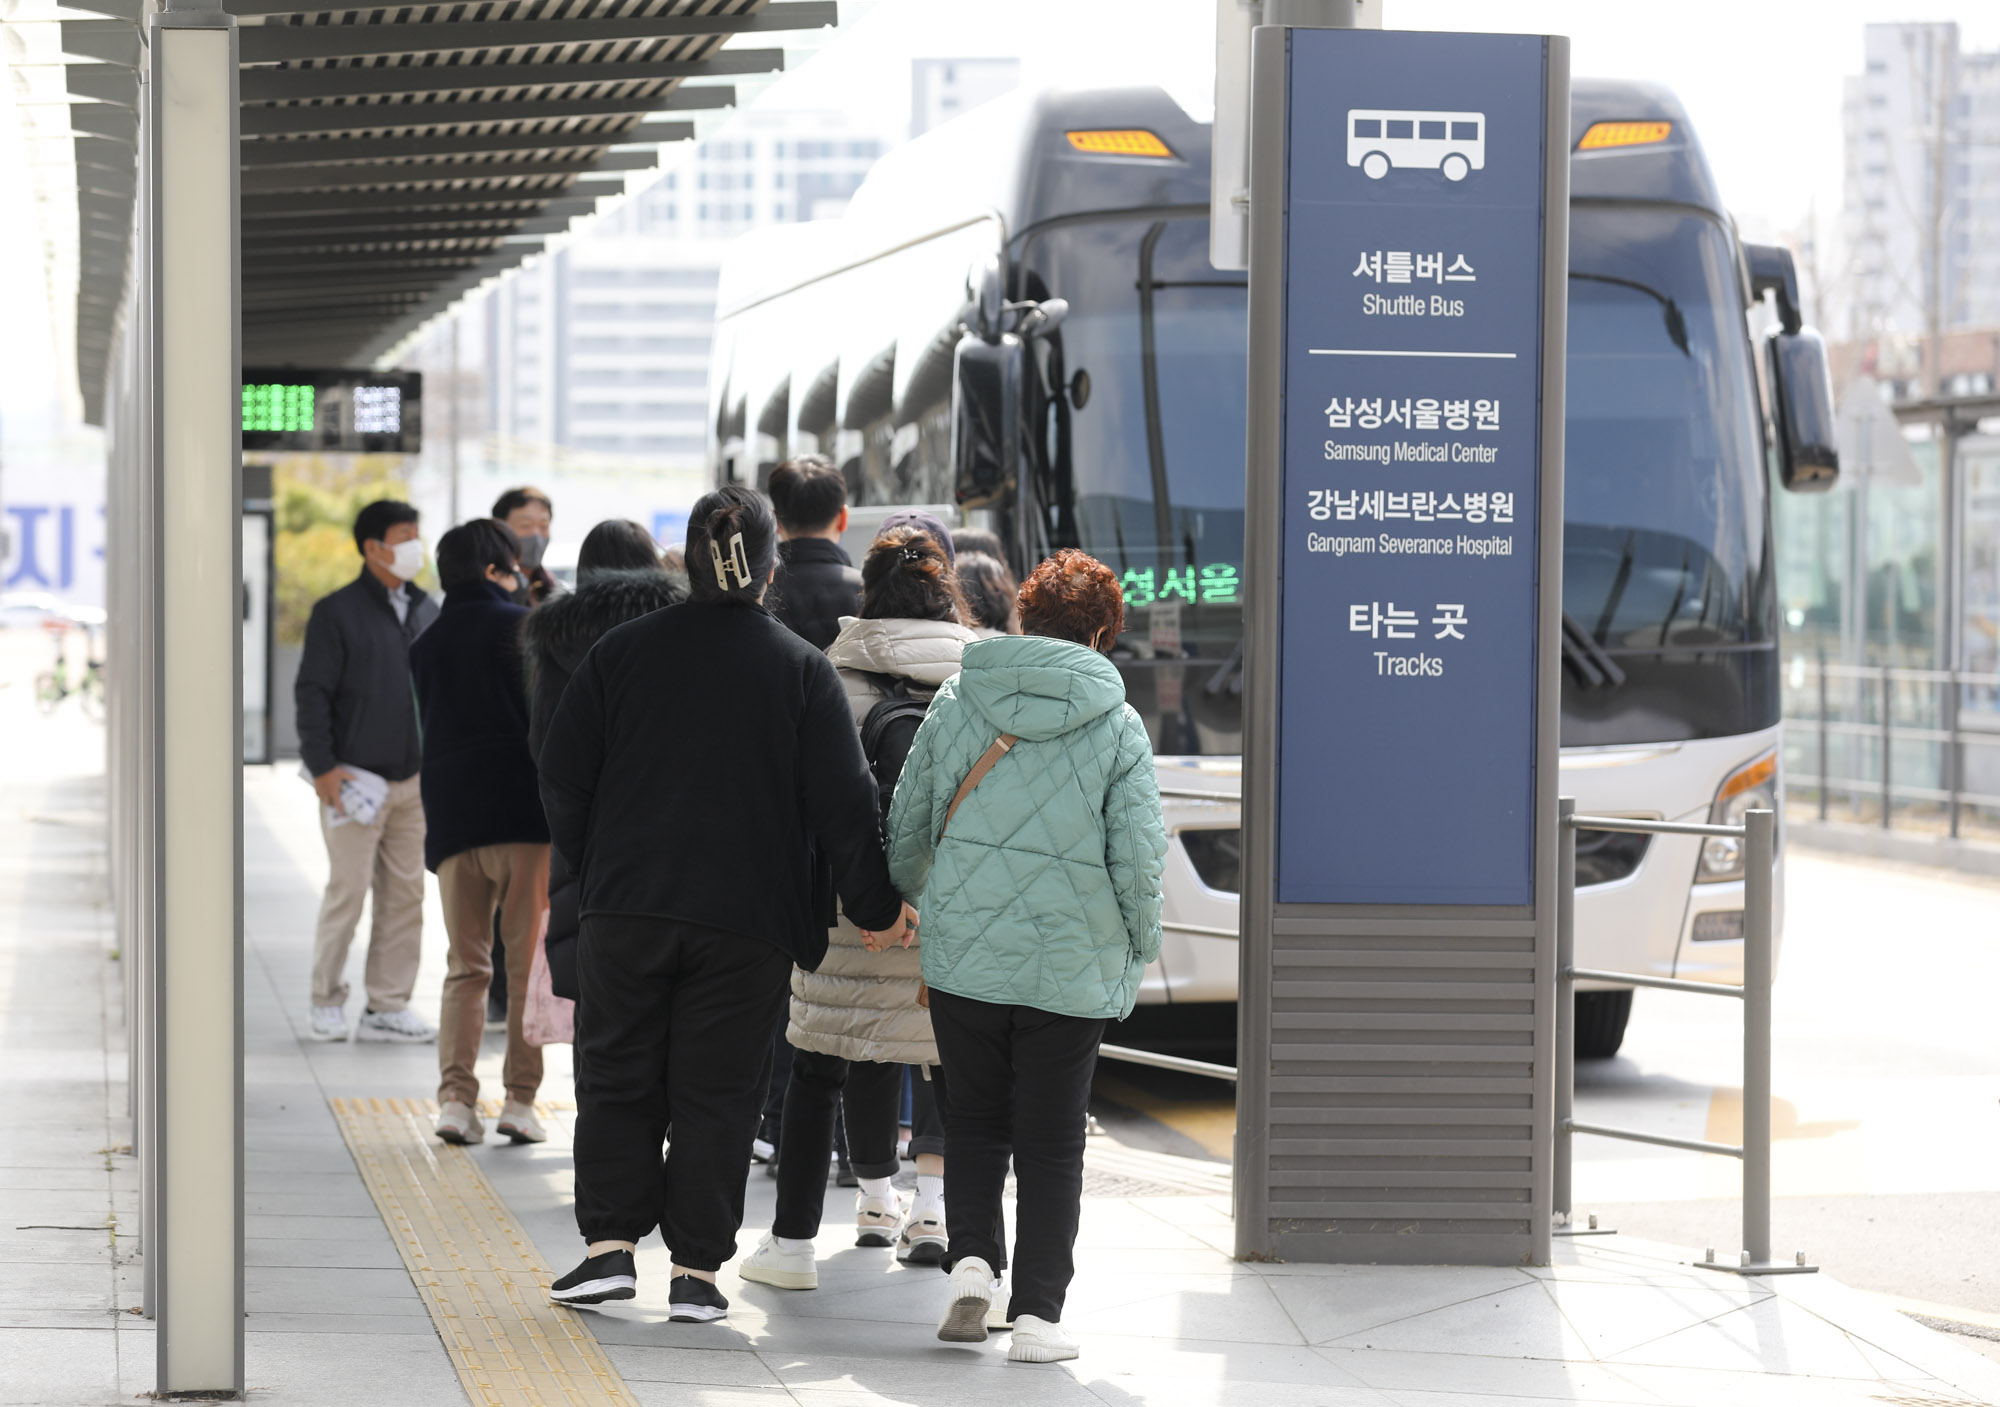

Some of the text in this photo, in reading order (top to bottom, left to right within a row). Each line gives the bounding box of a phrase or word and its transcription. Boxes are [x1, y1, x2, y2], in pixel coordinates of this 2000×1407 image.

[1353, 250, 1477, 285] 셔틀버스
[1362, 293, 1465, 317] Shuttle Bus
[1324, 397, 1500, 431] 삼성서울병원
[1324, 439, 1499, 466] Samsung Medical Center
[1307, 488, 1514, 524] 강남세브란스병원
[1307, 532, 1513, 560] Gangnam Severance Hospital
[1349, 601, 1468, 640] 타는 곳
[1373, 651, 1443, 677] Tracks
